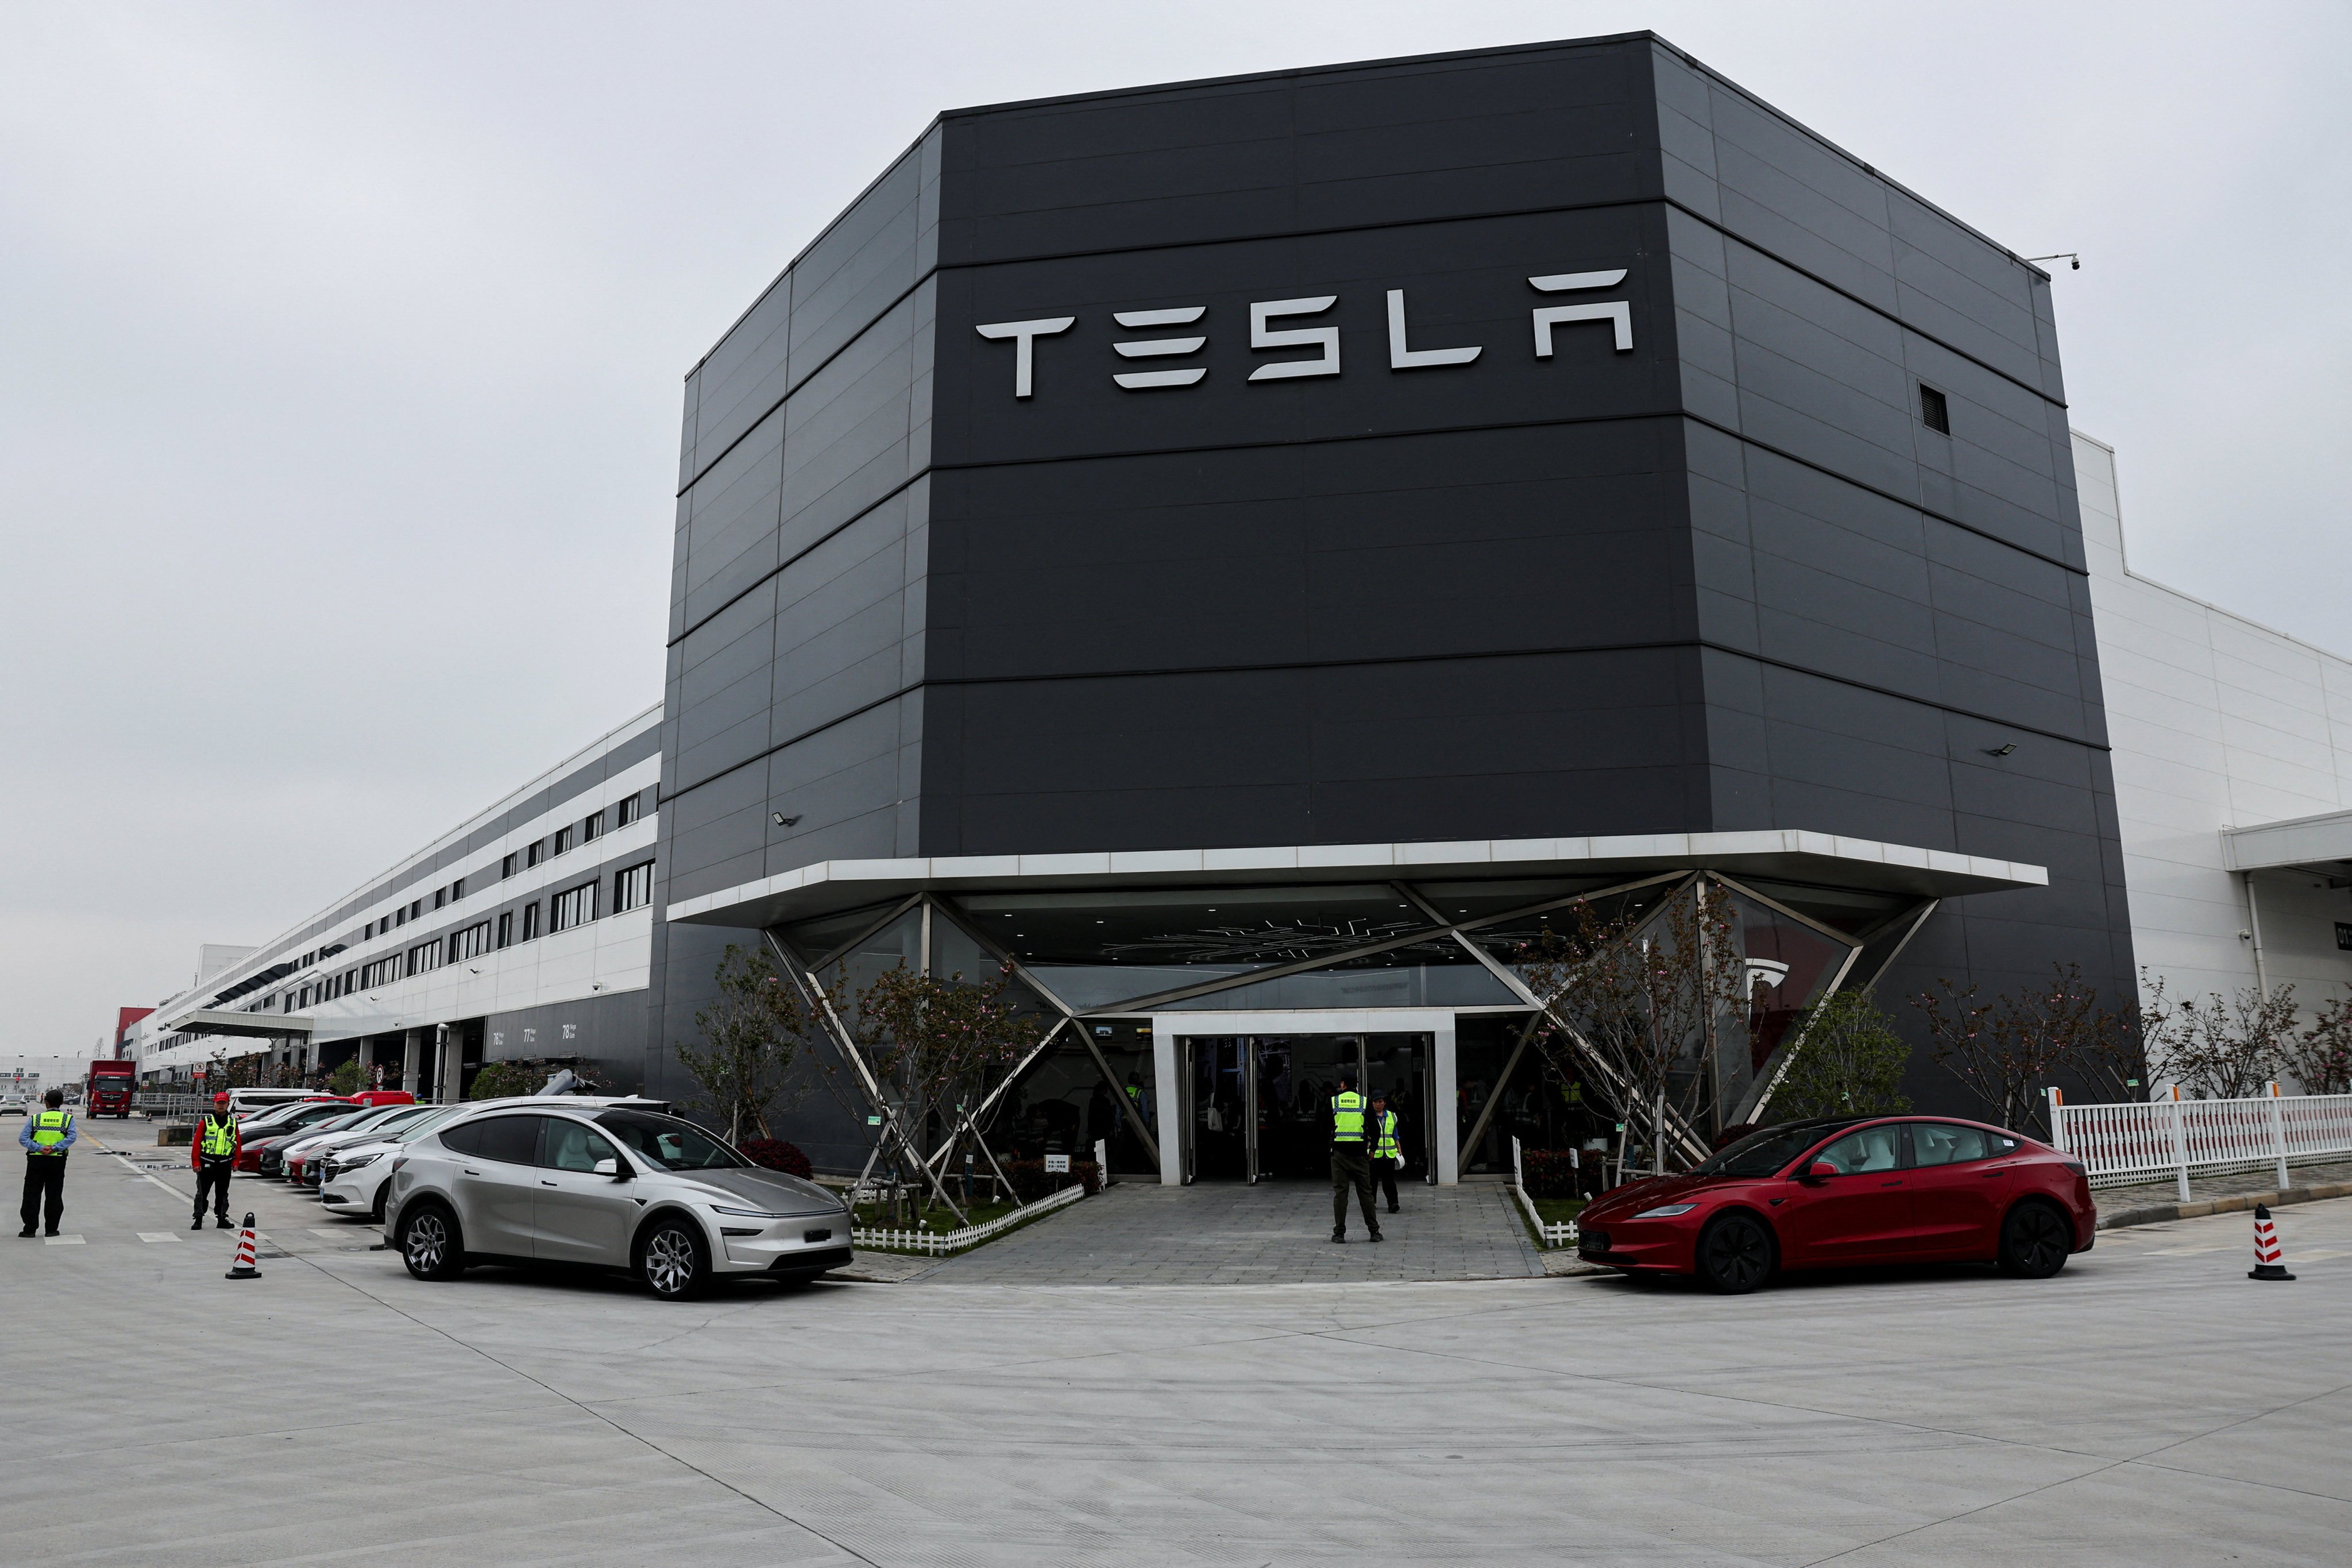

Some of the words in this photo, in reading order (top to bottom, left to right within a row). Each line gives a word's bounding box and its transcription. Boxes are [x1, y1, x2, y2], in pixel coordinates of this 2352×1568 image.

[975, 268, 1635, 398] TESLA
[2338, 928, 2349, 944] 01
[494, 1032, 499, 1045] 76
[524, 1029, 530, 1042] 77
[563, 1024, 569, 1039] 78
